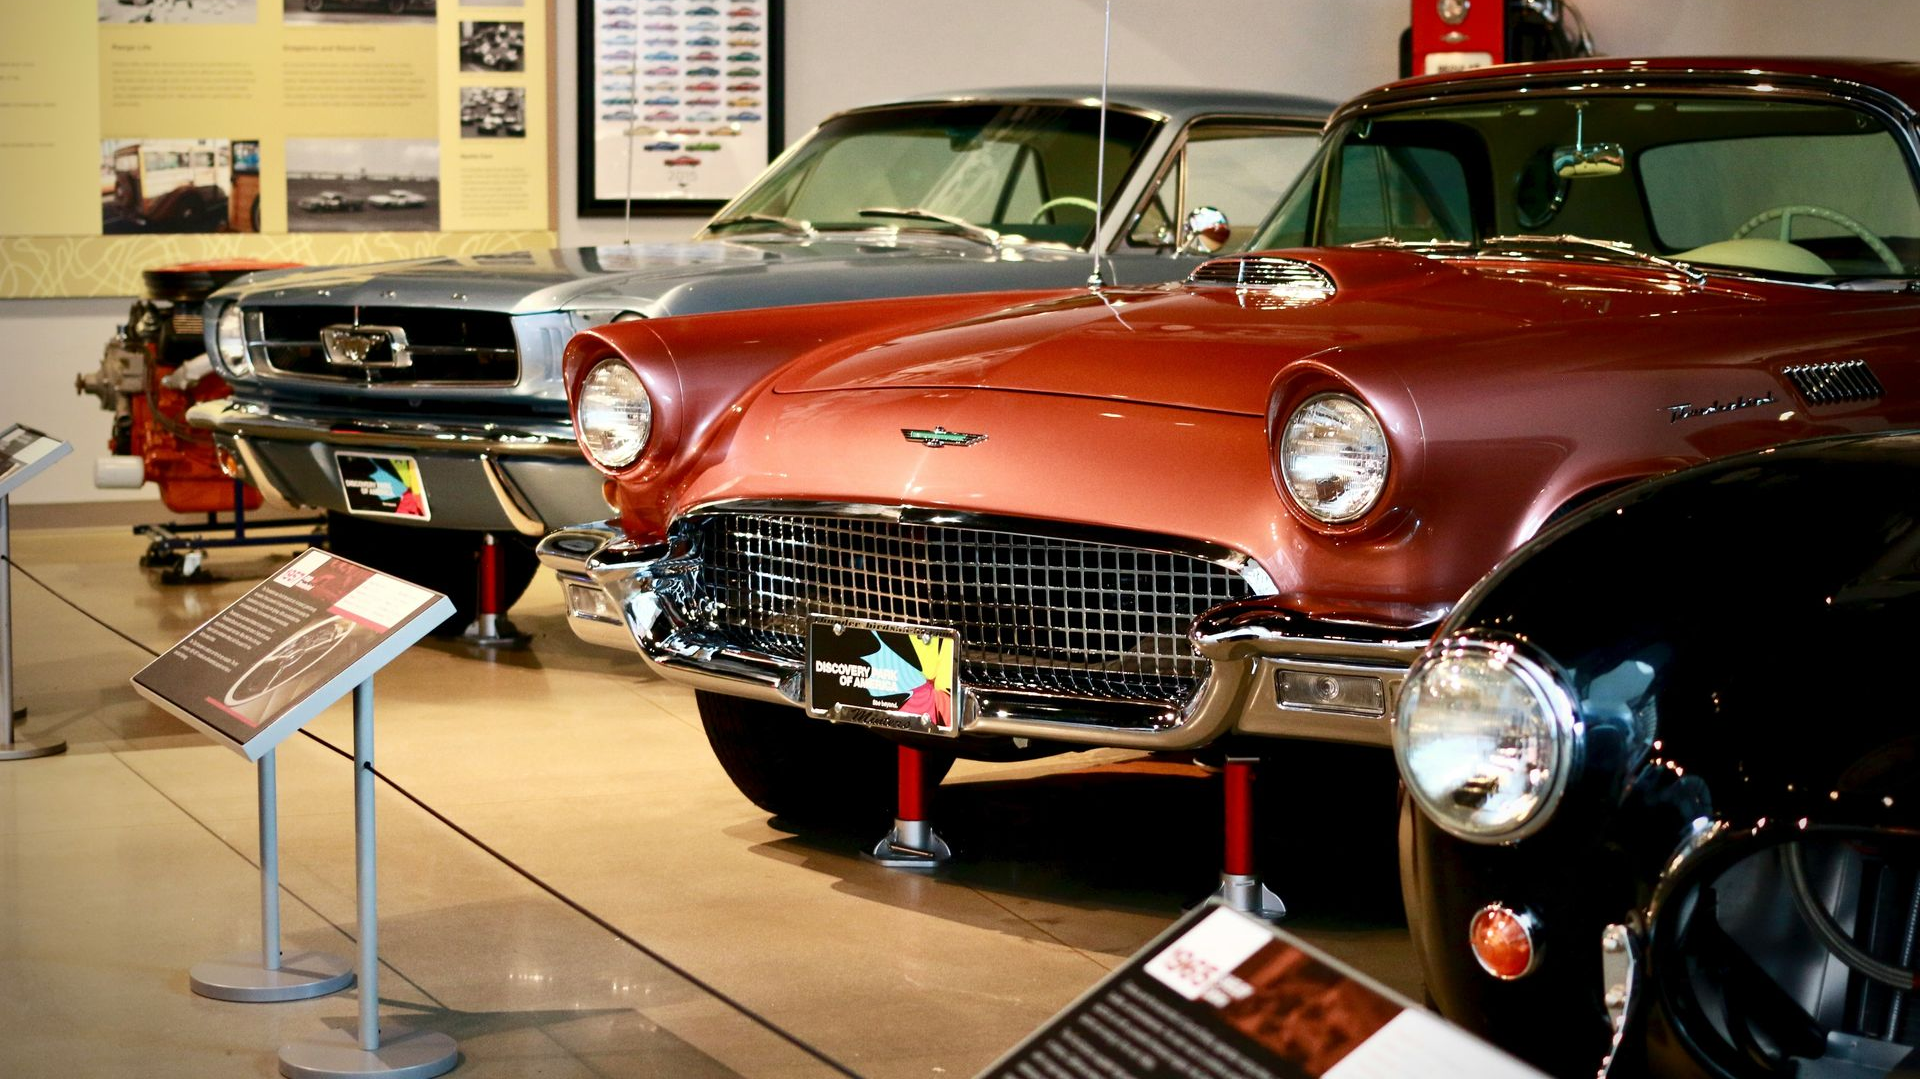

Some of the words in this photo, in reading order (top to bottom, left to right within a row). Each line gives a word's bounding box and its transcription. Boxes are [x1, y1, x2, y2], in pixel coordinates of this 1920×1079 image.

[815, 660, 871, 678] DISCOVERY
[872, 668, 898, 681] PARK
[839, 676, 853, 687] OF
[853, 678, 898, 692] AMERICA
